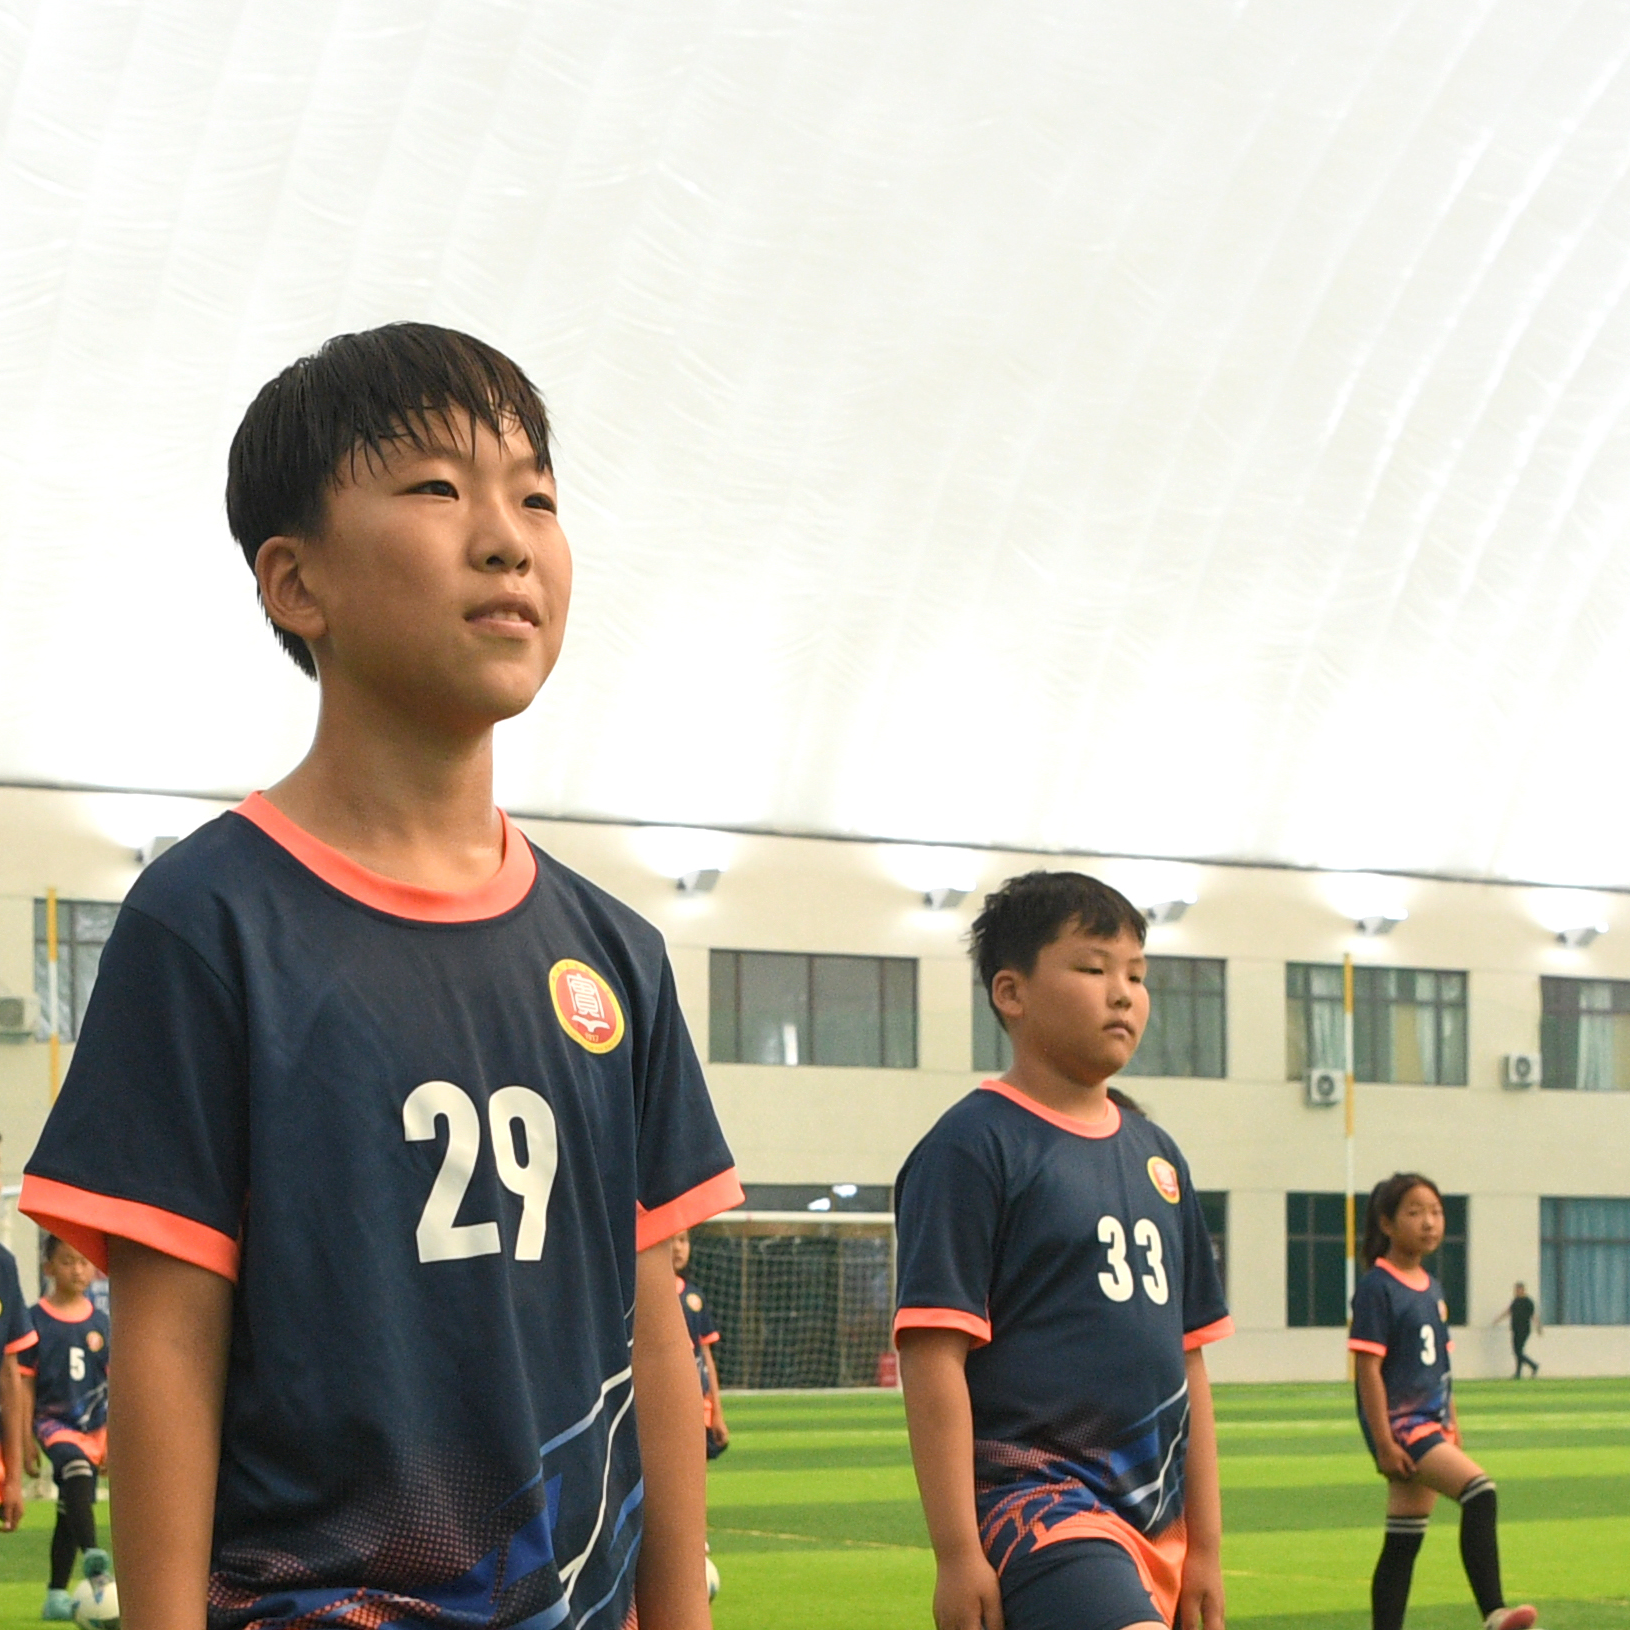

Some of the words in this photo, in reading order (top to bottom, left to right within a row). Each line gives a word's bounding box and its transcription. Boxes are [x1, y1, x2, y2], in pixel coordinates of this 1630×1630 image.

[402, 1080, 558, 1264] 29
[1097, 1215, 1169, 1306] 33
[69, 1346, 86, 1382] 5
[1419, 1323, 1437, 1366] 3
